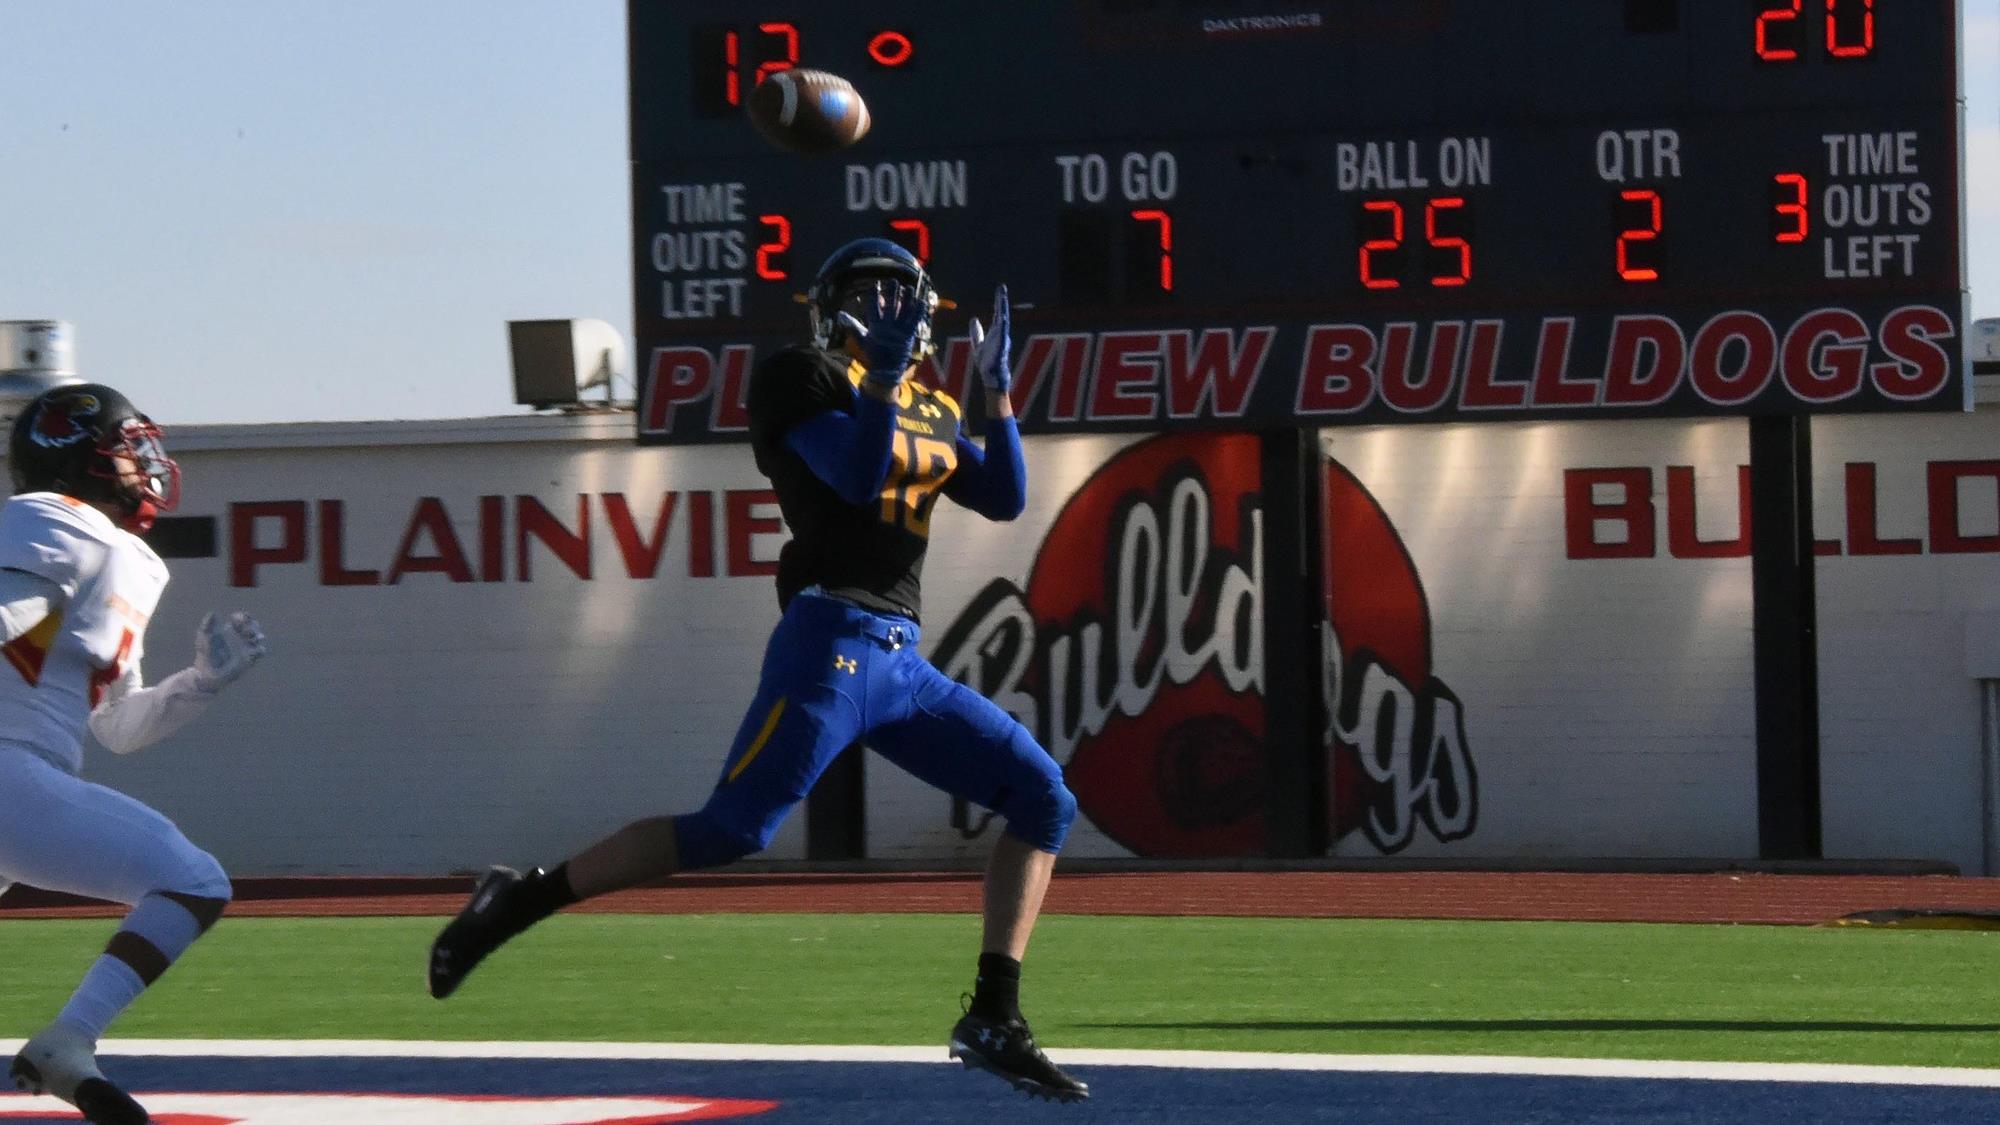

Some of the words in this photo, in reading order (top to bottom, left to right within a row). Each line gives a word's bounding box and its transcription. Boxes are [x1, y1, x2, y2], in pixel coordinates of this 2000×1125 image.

[1202, 12, 1322, 32] DAKTRONICS
[1755, 0, 1874, 60] 20
[1055, 155, 1109, 203] TO
[1121, 151, 1178, 201] GO
[1337, 140, 1428, 192] BALL
[1438, 137, 1492, 187] ON
[1596, 129, 1683, 182] QTR
[1822, 131, 1918, 174] TIME
[661, 182, 747, 224] TIME
[845, 160, 968, 212] DOWN
[1774, 173, 1808, 244] 3
[1823, 182, 1932, 228] OUTS
[651, 230, 748, 273] OUTS
[755, 214, 793, 280] 2
[1131, 209, 1173, 292] 7
[1359, 197, 1472, 289] 25
[1616, 190, 1661, 281] 2
[1823, 234, 1921, 279] LEFT
[661, 278, 748, 319] LEFT
[1294, 305, 1956, 417] BULLDOGS
[1563, 459, 2000, 560] BULD
[229, 490, 783, 587] PLAINVIE
